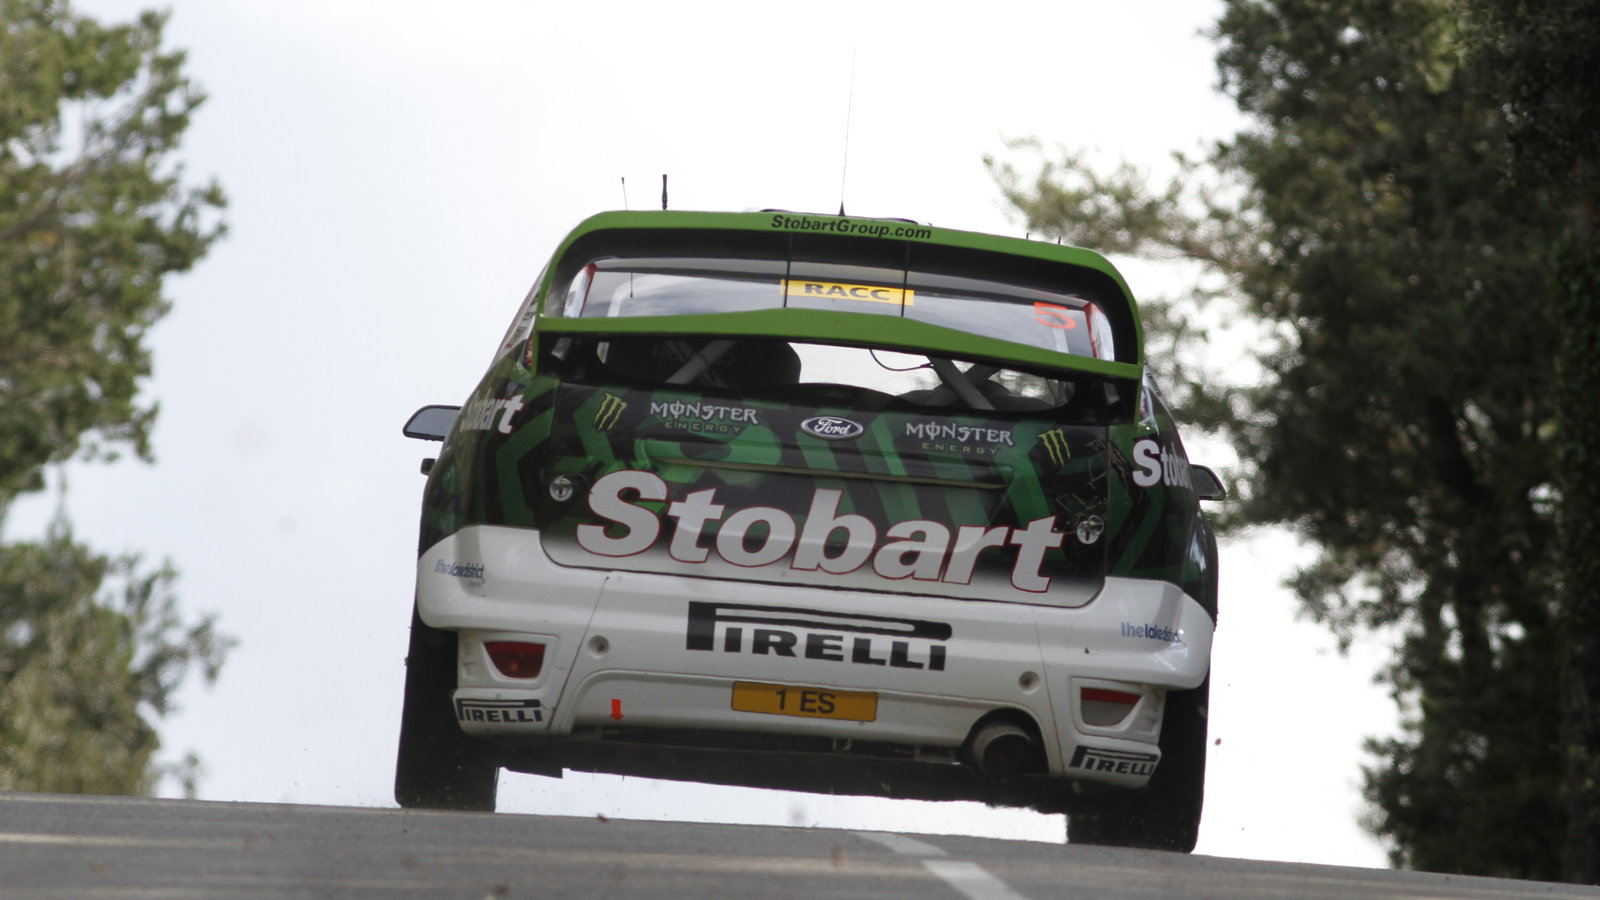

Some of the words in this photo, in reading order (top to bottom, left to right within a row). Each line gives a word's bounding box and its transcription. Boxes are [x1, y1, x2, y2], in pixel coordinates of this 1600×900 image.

[771, 214, 932, 239] StobartGroup.com
[804, 282, 890, 301] RACC
[1033, 301, 1077, 330] 5
[649, 400, 759, 425] MONSTER
[664, 421, 741, 433] ENERGY
[812, 417, 852, 436] Ford
[905, 421, 1014, 446] MONSTER
[920, 442, 998, 455] ENERGY
[576, 469, 1065, 593] Stobart
[686, 600, 953, 672] PIRELLI
[455, 698, 543, 723] PIRELLI
[775, 688, 788, 710] 1
[799, 690, 836, 714] ES
[1069, 745, 1158, 776] PIRELLI
